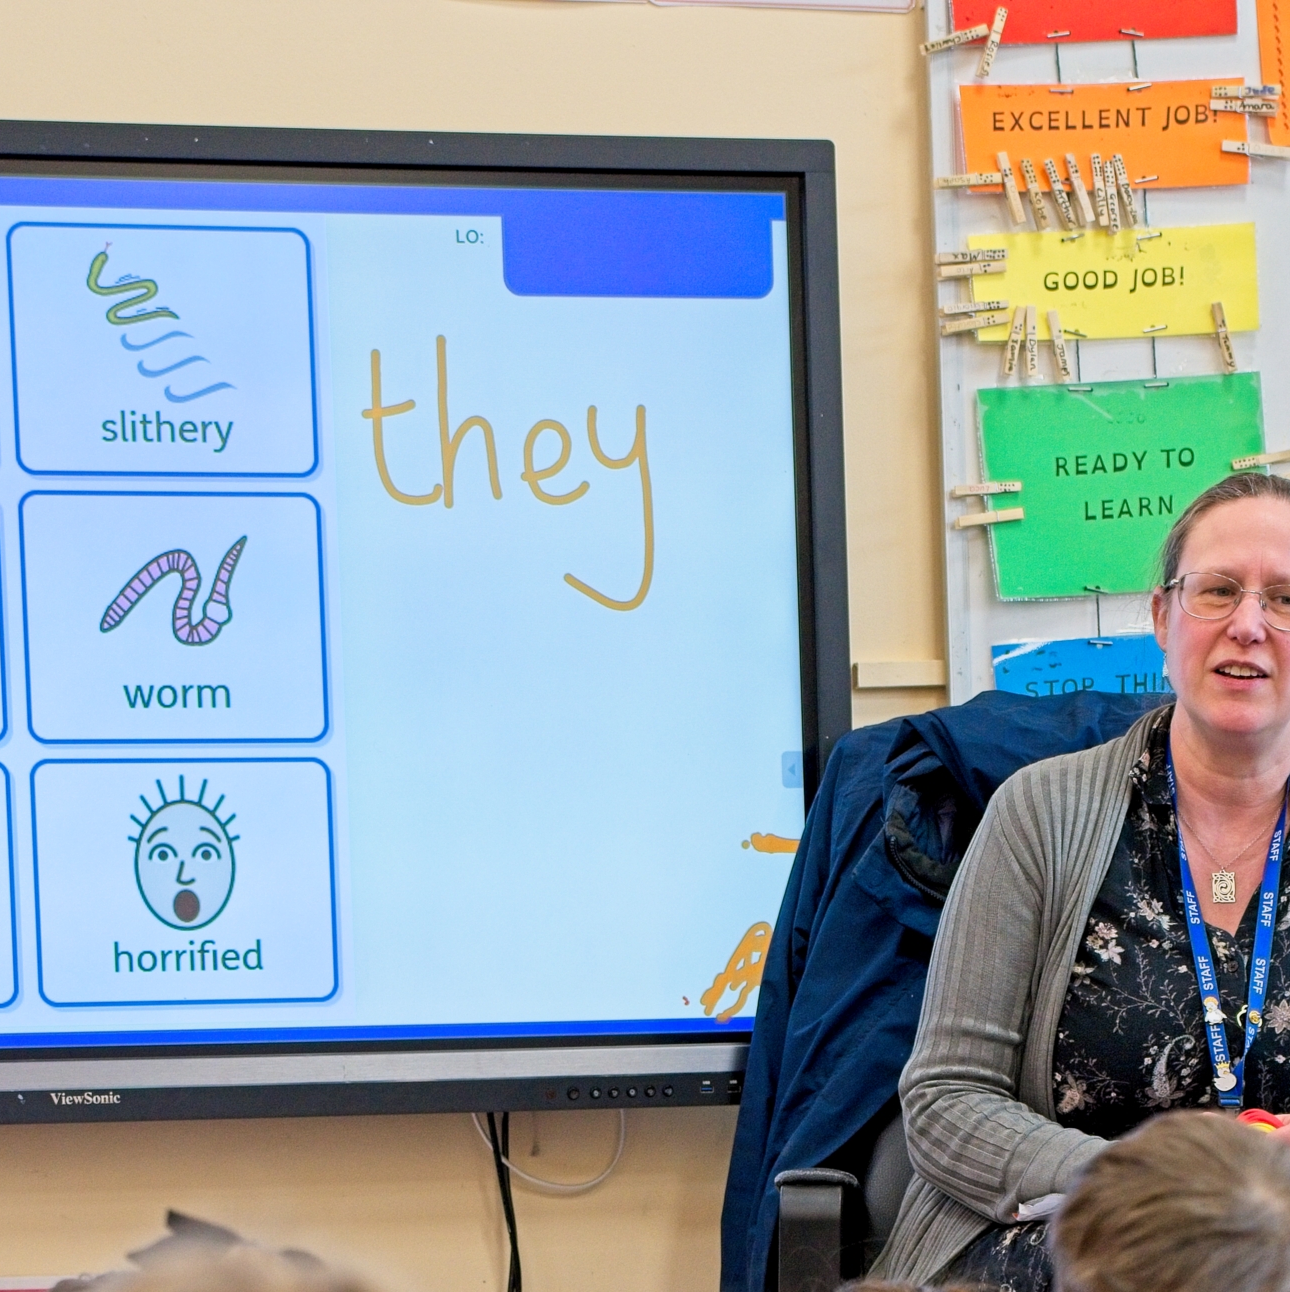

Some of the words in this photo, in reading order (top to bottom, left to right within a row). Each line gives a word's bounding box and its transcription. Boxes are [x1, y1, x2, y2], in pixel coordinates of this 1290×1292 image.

[991, 106, 1152, 133] EXCELLENT
[1162, 104, 1218, 130] JOB!
[1239, 101, 1275, 111] Amara
[1033, 191, 1047, 220] Kobe
[1057, 188, 1076, 225] Arthur
[1109, 193, 1119, 230] George
[455, 229, 485, 245] LO:
[952, 252, 980, 261] Max
[1043, 270, 1119, 292] GOOD
[1130, 265, 1186, 294] JOB!
[1028, 338, 1036, 371] Dylan
[1056, 344, 1071, 377] James
[101, 410, 234, 453] slithery
[361, 335, 654, 612] they
[1055, 450, 1147, 477] READY
[1160, 447, 1195, 469] TO
[1085, 495, 1174, 521] LEARN
[123, 681, 232, 710] worm
[1025, 677, 1095, 698] STOP
[1269, 829, 1282, 861] STAFF
[1186, 890, 1201, 925] STAFF
[1260, 891, 1274, 927] STAFF
[114, 939, 264, 973] horrified
[1197, 956, 1214, 991] STAFF
[1252, 958, 1266, 995] STAFF
[1210, 1024, 1226, 1062] STAFF
[50, 1091, 121, 1105] ViewSonic
